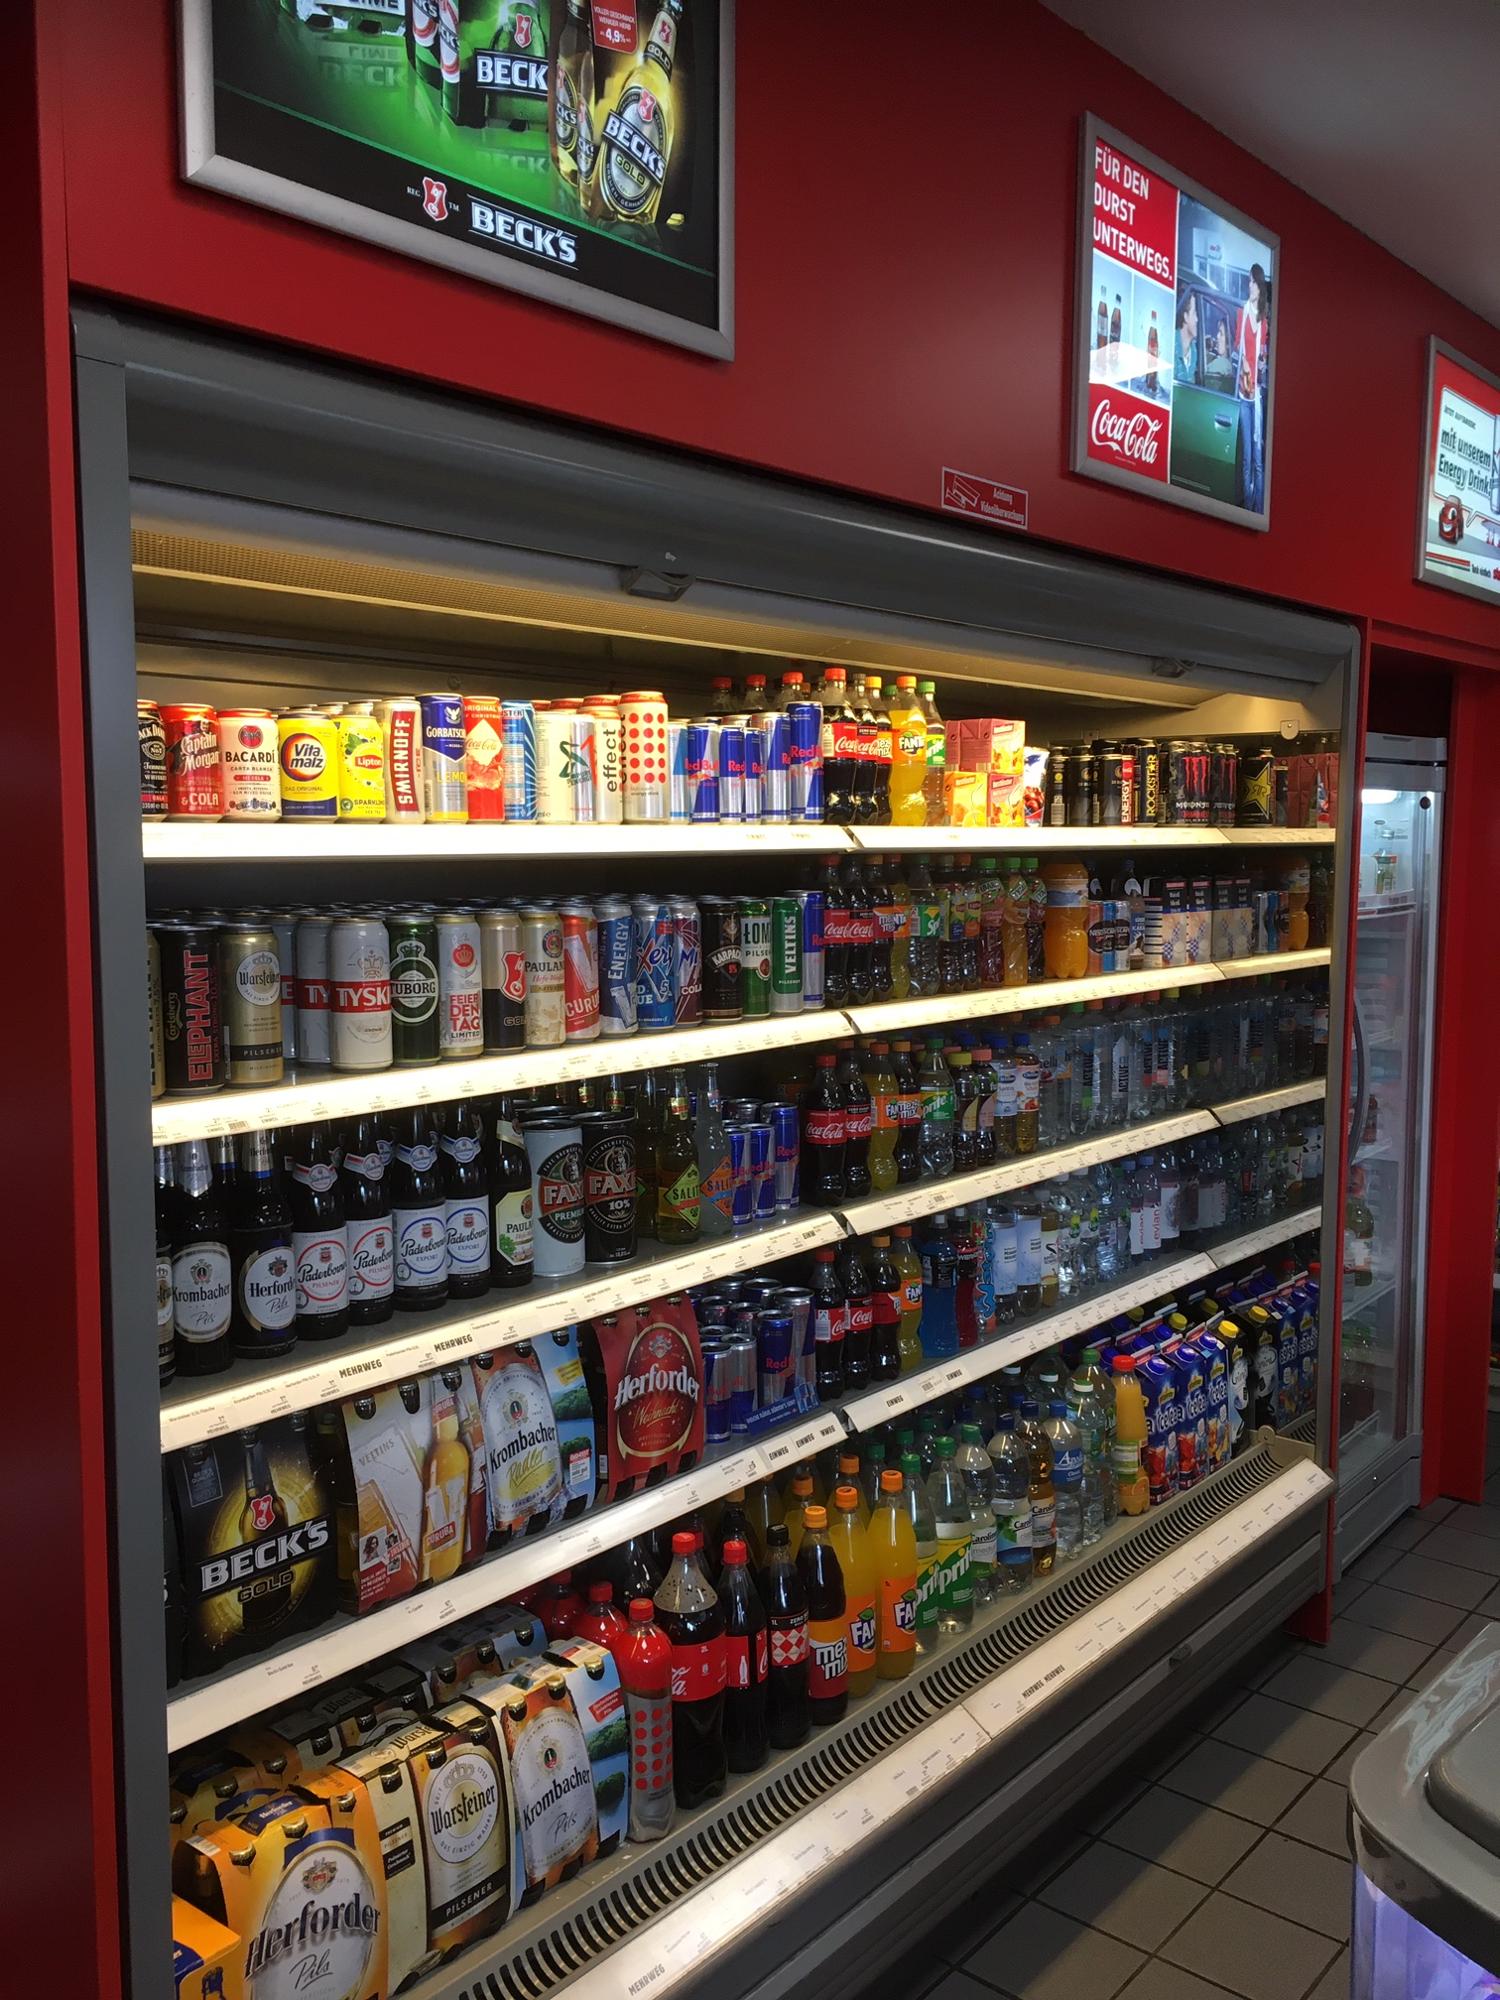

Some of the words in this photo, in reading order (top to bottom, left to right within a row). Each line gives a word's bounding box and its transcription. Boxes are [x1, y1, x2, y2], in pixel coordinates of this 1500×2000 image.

[647, 44, 671, 69] GOLD
[477, 55, 547, 91] BECK
[604, 115, 667, 179] BECK'S
[614, 153, 646, 186] GOLD
[1095, 146, 1120, 183] FÜR
[1123, 164, 1149, 200] DEN
[449, 202, 460, 212] TM
[1094, 181, 1136, 226] DURST
[471, 201, 577, 264] BECK'S
[1093, 217, 1173, 281] UNTERWEGS.
[1091, 399, 1163, 464] Coca-Cola
[1441, 427, 1456, 448] mit
[1457, 437, 1491, 469] unserem
[1438, 453, 1466, 489] Energy
[181, 732, 217, 757] Captain
[294, 744, 321, 758] Vita
[791, 746, 815, 758] Red
[181, 751, 219, 777] Morgan
[290, 757, 324, 769] malz
[357, 757, 382, 767] Lipton
[393, 719, 414, 805] SMIRNOFF
[603, 728, 618, 793] effect
[437, 771, 467, 784] LEMO
[189, 793, 219, 806] COLA
[1122, 780, 1132, 823] ENERGY
[743, 923, 771, 945] ŁOM
[785, 915, 797, 974] VELTINS
[608, 921, 630, 980] ENERGY
[335, 987, 391, 1007] TYSKI
[638, 995, 653, 1005] UE
[681, 983, 703, 995] COL
[168, 992, 182, 1041] Carlsberg
[184, 950, 213, 1082] ELEPHANT
[450, 1003, 480, 1018] DEN
[565, 990, 600, 1018] CURU
[450, 1017, 480, 1032] TAG
[451, 1031, 480, 1040] LIMITED
[1118, 1062, 1129, 1093] ACTIVE
[923, 1093, 949, 1117] prite
[805, 1122, 845, 1140] Coca-Cola
[543, 1180, 584, 1205] FAX
[608, 1199, 631, 1210] 10%
[1153, 1209, 1161, 1241] evian
[416, 1253, 439, 1263] EXPORT
[457, 1243, 481, 1252] EXPORT
[172, 1281, 231, 1303] Krombacher
[249, 1274, 296, 1300] Herford
[905, 1286, 922, 1301] FAN
[265, 1297, 290, 1314] Pils
[192, 1311, 216, 1327] Pils
[434, 1333, 473, 1353] MEHRWEG
[340, 1358, 383, 1379] MEHRWEG
[765, 1356, 788, 1369] Red
[945, 1368, 963, 1381] EINWEG
[614, 1363, 700, 1411] Herforder
[886, 1394, 904, 1409] EINWEG
[358, 1438, 395, 1467] VELTINS
[488, 1421, 556, 1472] Krombacher
[769, 1445, 790, 1461] EINWEG
[796, 1432, 815, 1448] EINWEG
[506, 1446, 548, 1488] Radler
[201, 1519, 329, 1592] BECK'S
[938, 1542, 972, 1593] prit
[237, 1570, 296, 1606] GOLD
[790, 1616, 804, 1625] ZERO
[1022, 1678, 1045, 1700] MEHRWEG
[1044, 1664, 1066, 1683] MEHRWEG
[430, 1784, 496, 1836] Warsteiner
[522, 1766, 591, 1832] Krombacher
[551, 1811, 577, 1844] Pils
[445, 1881, 493, 1917] PILSENER
[244, 1892, 382, 1979] Herforder
[288, 1948, 335, 1991] Pils
[628, 1963, 666, 1997] MEHRWEG
